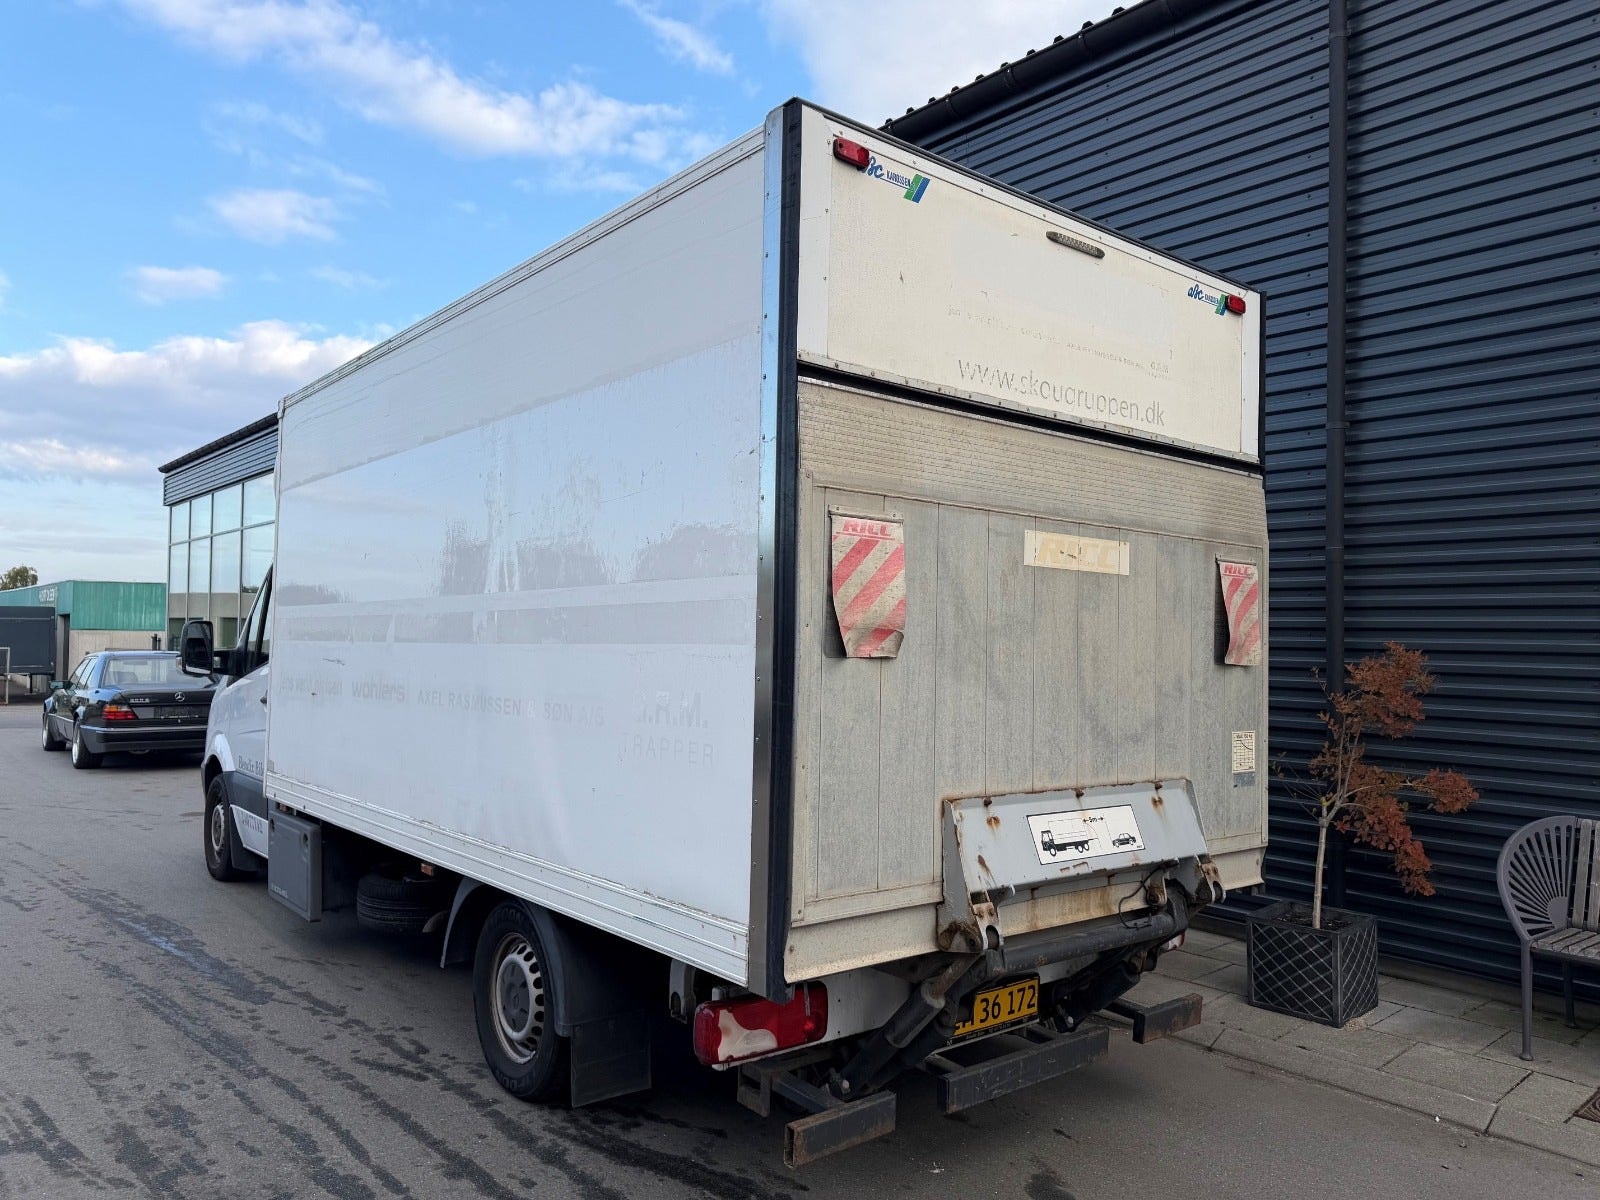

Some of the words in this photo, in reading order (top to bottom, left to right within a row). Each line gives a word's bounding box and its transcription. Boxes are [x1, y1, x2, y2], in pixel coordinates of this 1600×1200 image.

[862, 156, 884, 178] bc
[1188, 284, 1204, 301] abc
[979, 993, 1002, 1024] 36
[1007, 984, 1036, 1016] 172
